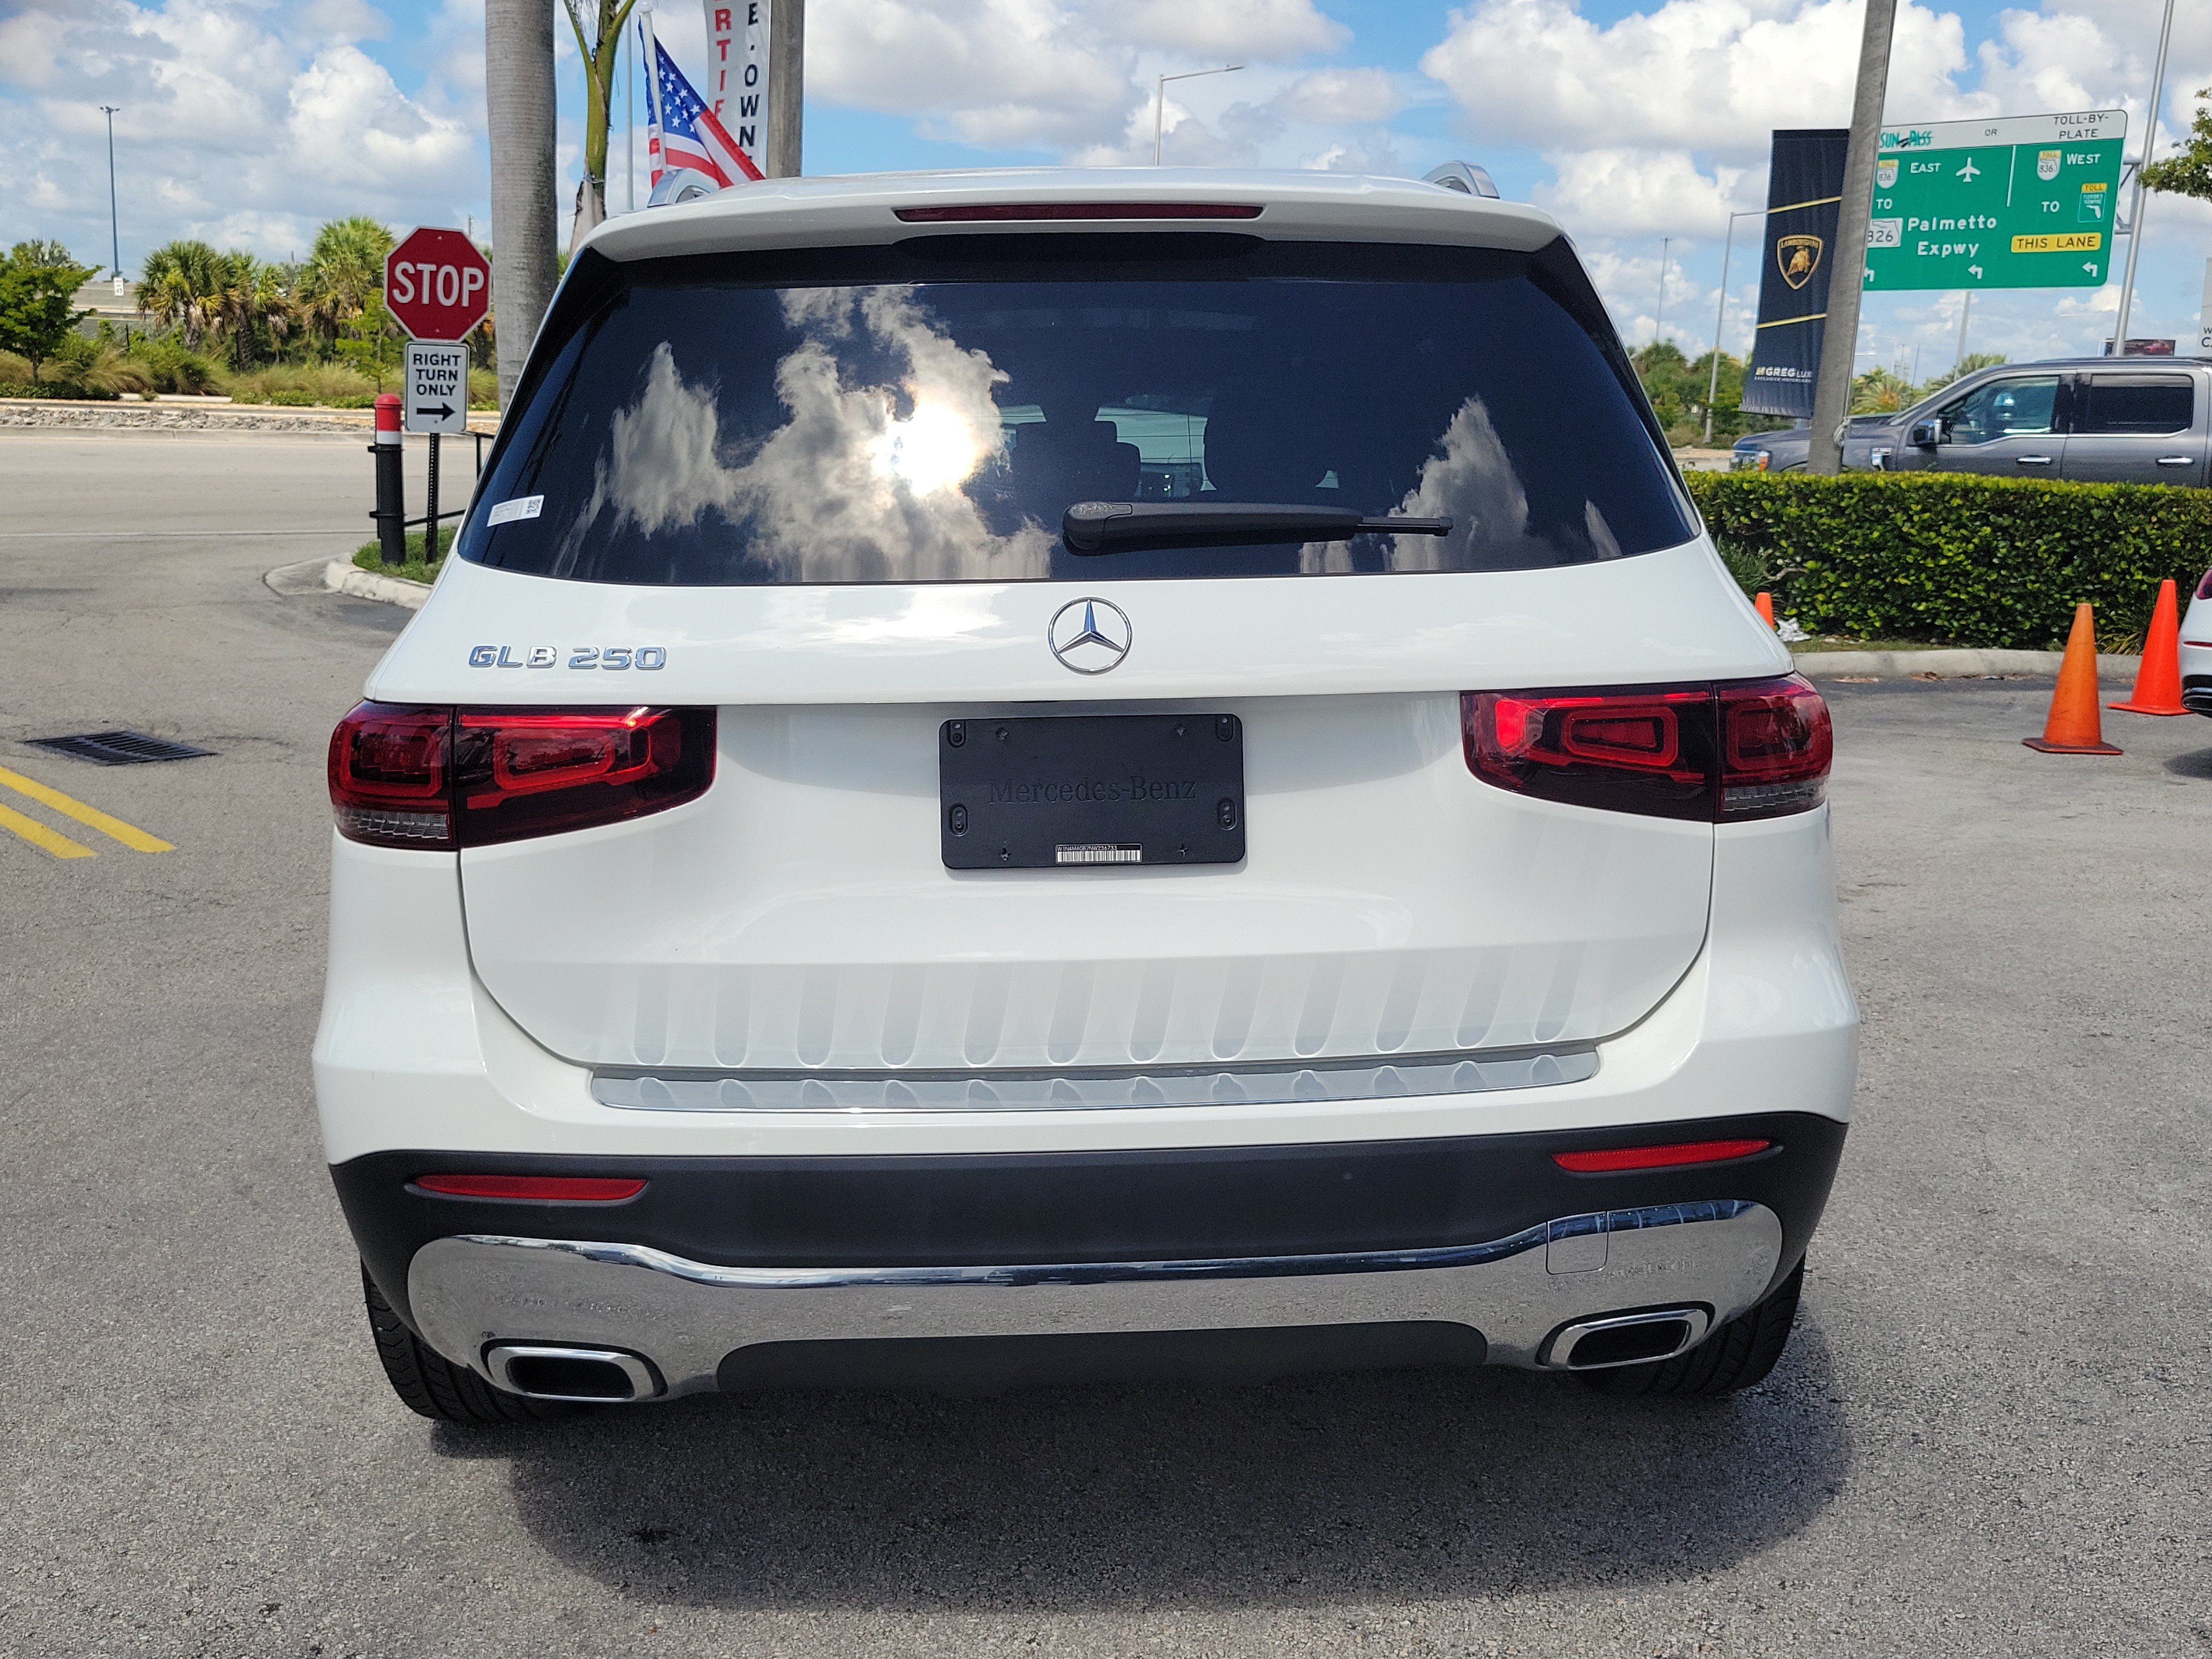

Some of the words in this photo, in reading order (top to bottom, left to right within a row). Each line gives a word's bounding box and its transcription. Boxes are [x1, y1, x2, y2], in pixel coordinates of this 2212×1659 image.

[714, 0, 731, 119] RTIF
[2058, 128, 2098, 139] PLATE
[2067, 153, 2101, 165] WEST
[1910, 162, 1941, 173] EAST
[2039, 165, 2053, 173] 836
[1876, 198, 1893, 210] TO
[2041, 200, 2060, 212] TO
[1908, 215, 1997, 232] Palmetto
[2017, 238, 2048, 249] THIS
[2056, 236, 2096, 248] LANE
[1917, 241, 1979, 258] Expwy
[392, 261, 485, 307] STOP
[413, 353, 461, 366] RIGHT
[416, 369, 458, 381] TURN
[416, 384, 455, 396] ONLY
[468, 645, 557, 668] GLB
[567, 646, 667, 670] 250
[988, 775, 1198, 804] Mercedes-Benz
